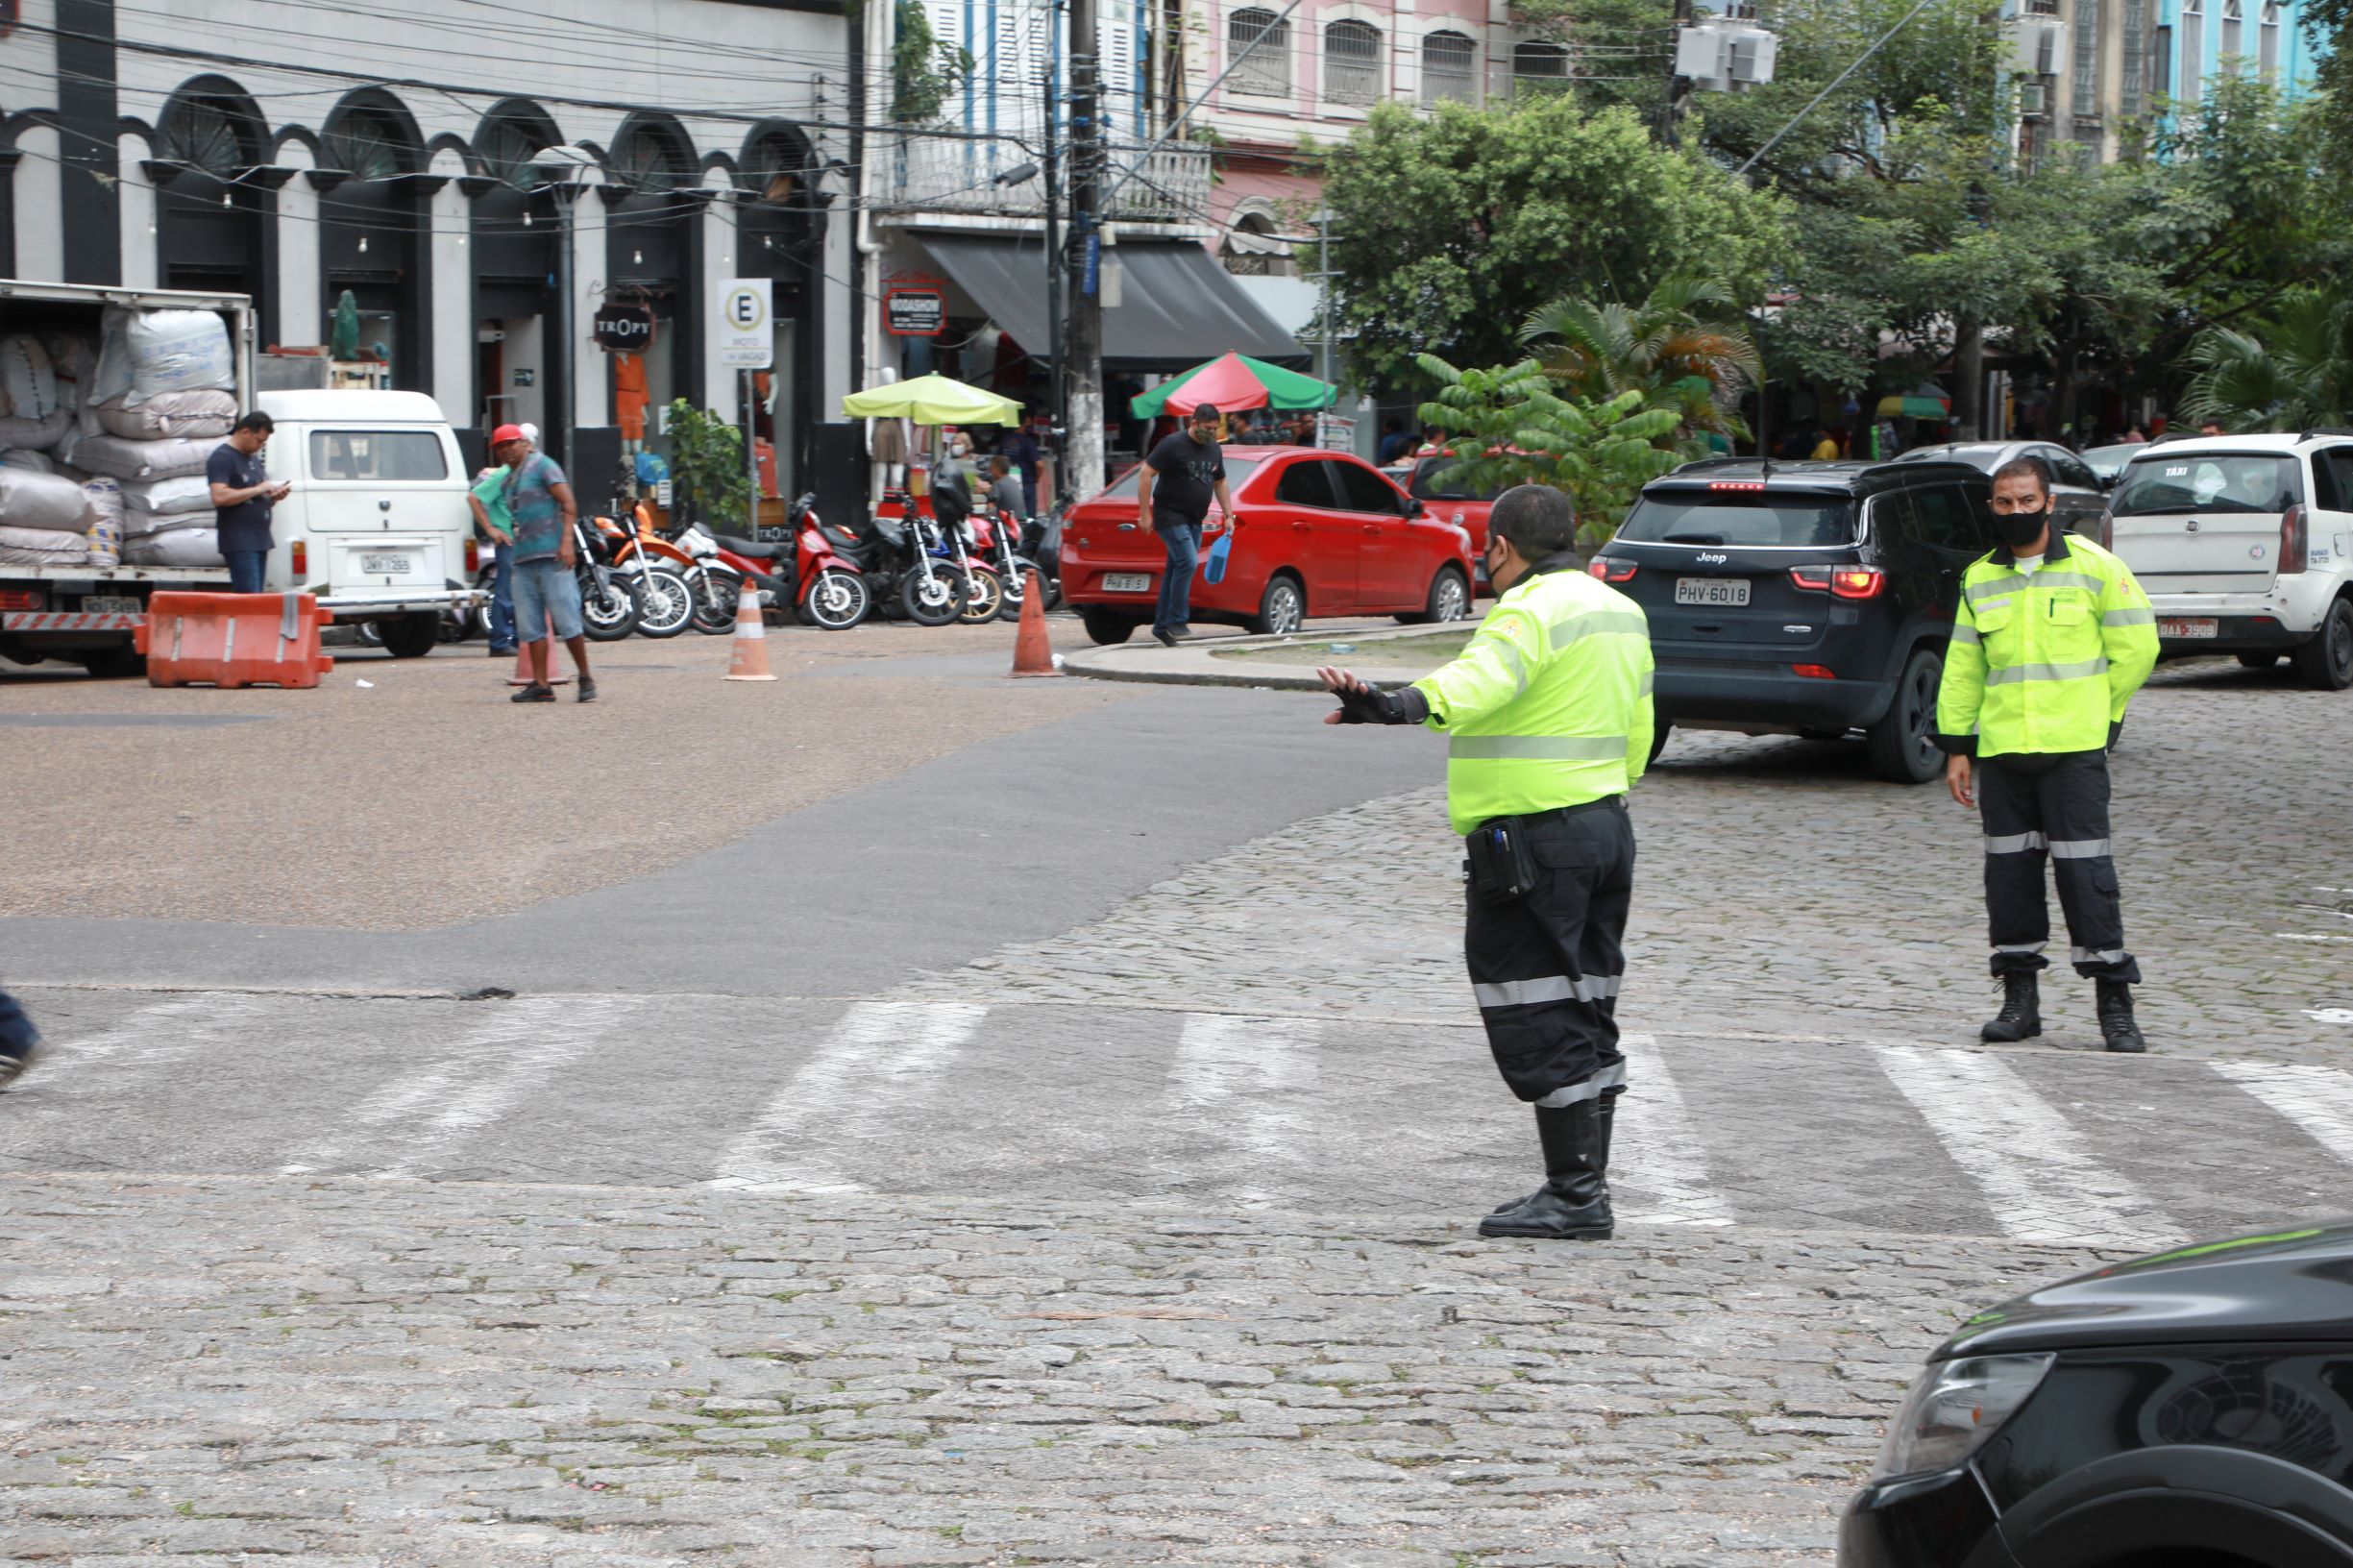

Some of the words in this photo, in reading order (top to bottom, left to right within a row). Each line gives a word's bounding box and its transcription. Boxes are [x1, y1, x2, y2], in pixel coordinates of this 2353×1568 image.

[737, 295, 752, 321] E
[598, 319, 650, 336] TROPY
[1696, 551, 1728, 565] Jeep
